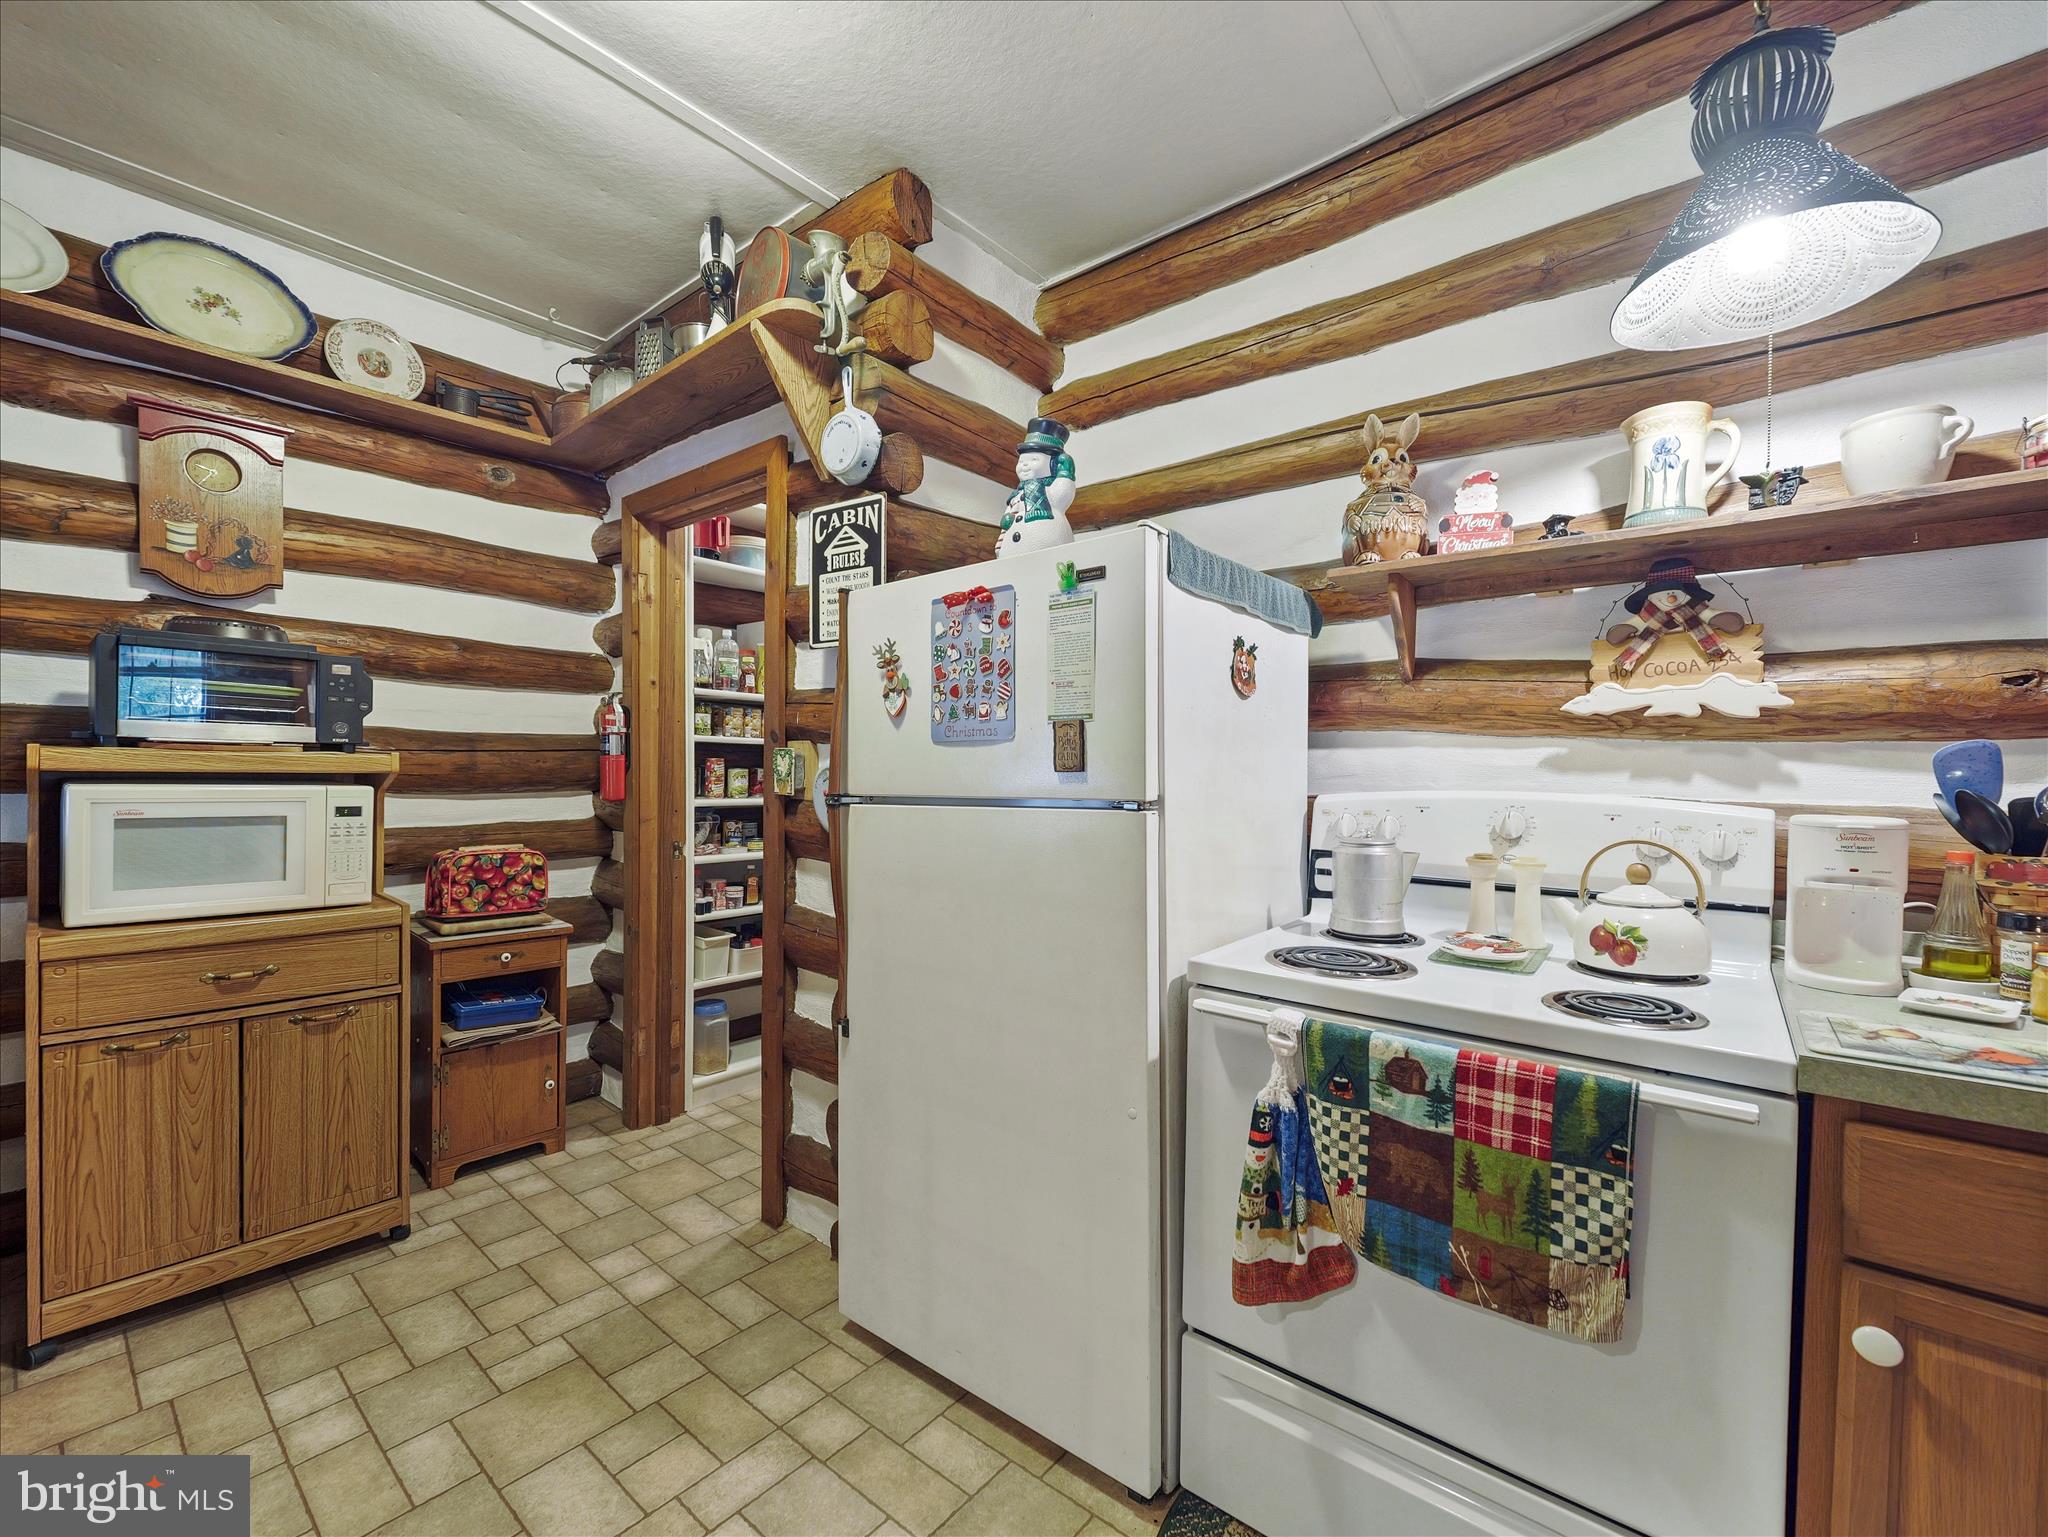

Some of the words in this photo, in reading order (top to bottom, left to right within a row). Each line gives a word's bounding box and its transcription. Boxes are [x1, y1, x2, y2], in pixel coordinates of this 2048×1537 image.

[814, 503, 880, 544] CABIN
[1456, 514, 1496, 531] Merry
[833, 551, 860, 568] RULES
[826, 576, 840, 584] COUNT
[842, 574, 851, 582] THE
[853, 571, 869, 580] STARS
[945, 605, 987, 619] Countdown
[968, 623, 973, 632] 3
[1643, 659, 1701, 677] COCOA
[944, 725, 999, 738] Christmas
[1058, 752, 1078, 760] CABIN
[1836, 832, 1876, 842] Sunbeam
